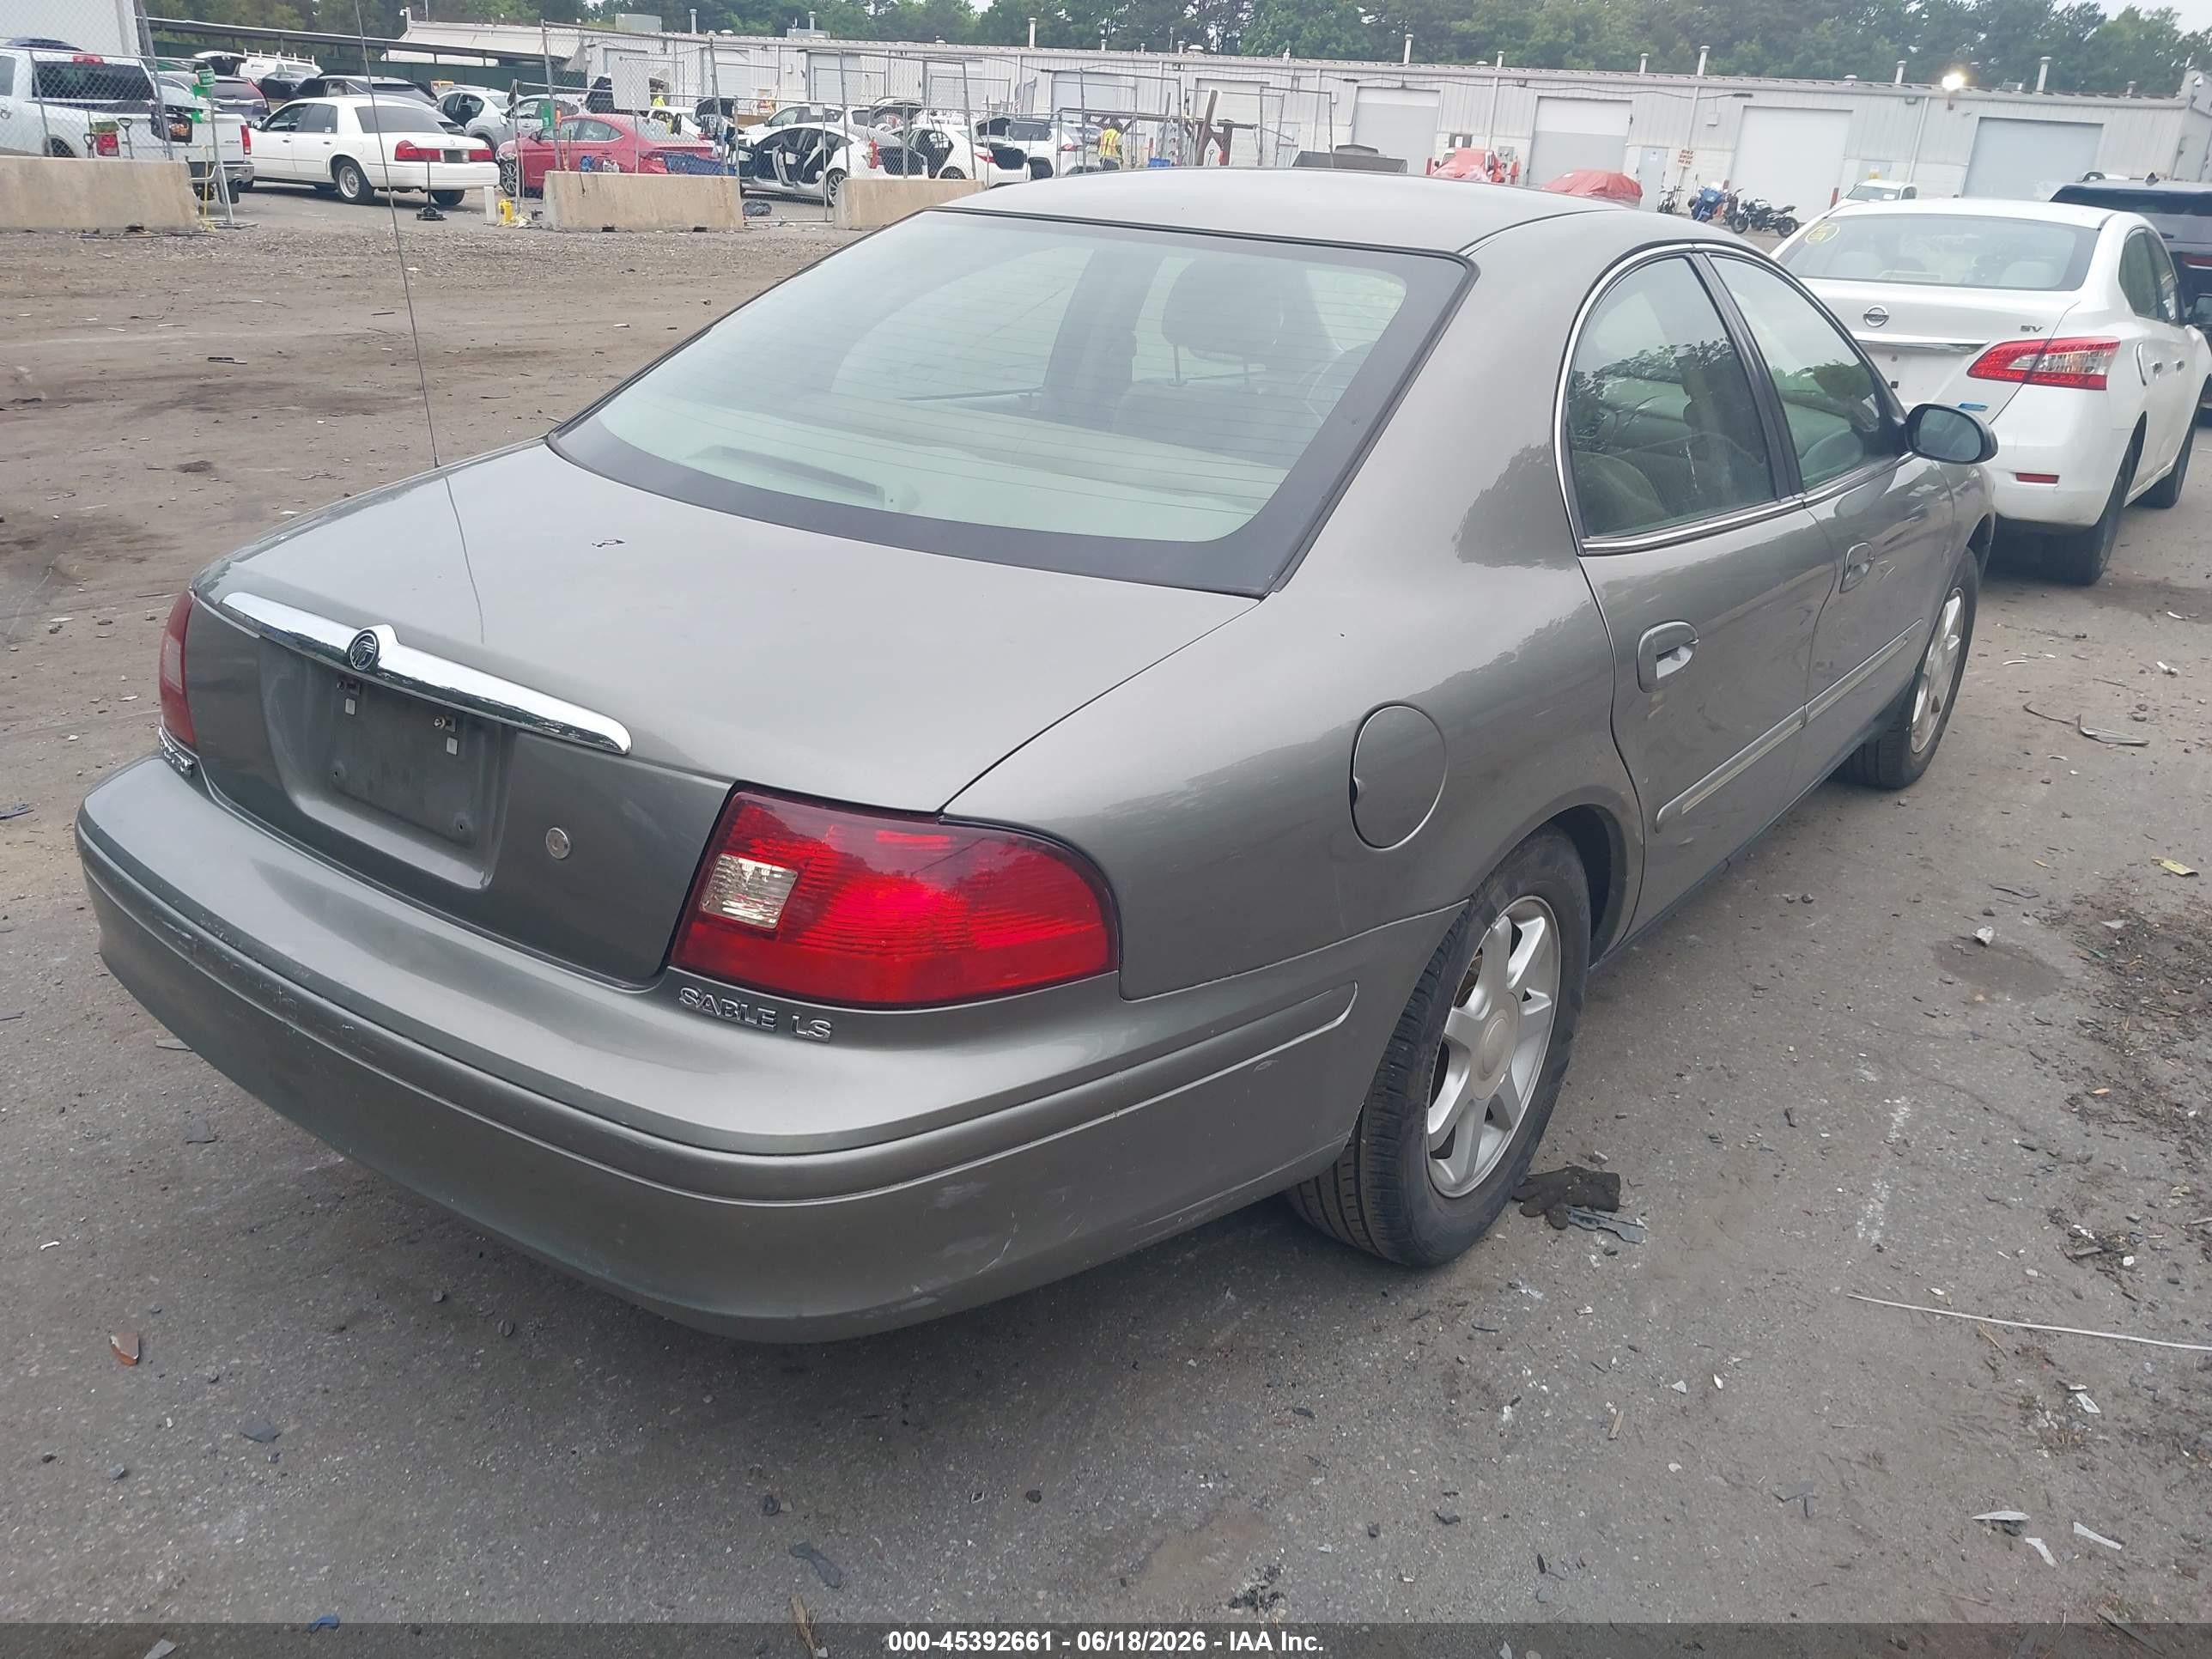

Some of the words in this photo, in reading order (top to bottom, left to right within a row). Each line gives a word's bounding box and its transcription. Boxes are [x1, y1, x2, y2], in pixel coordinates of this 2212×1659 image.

[2020, 325, 2045, 333] SV
[678, 987, 777, 1032] SABLE
[791, 1014, 832, 1042] LS
